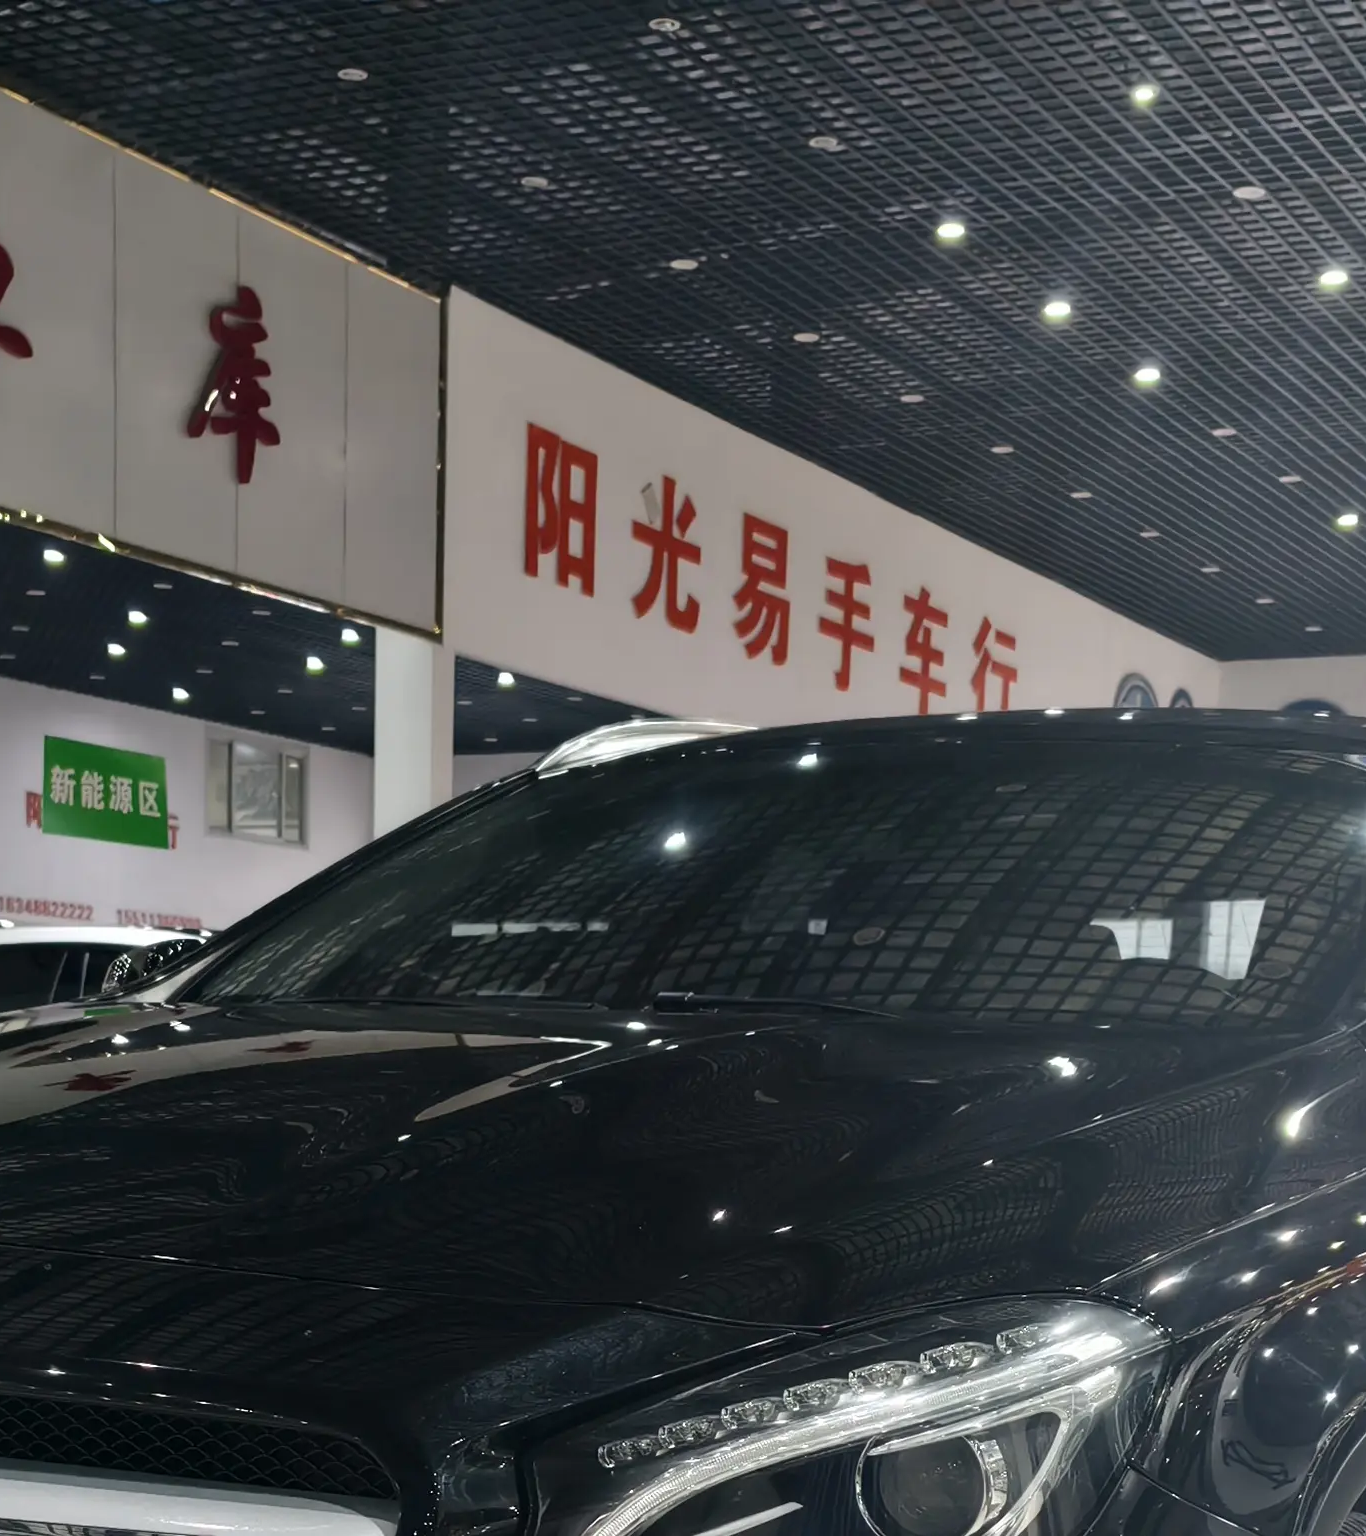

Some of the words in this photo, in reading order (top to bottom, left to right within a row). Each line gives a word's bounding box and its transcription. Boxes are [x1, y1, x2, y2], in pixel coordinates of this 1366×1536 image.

[524, 421, 1018, 716] 阳光易手车行
[50, 764, 161, 818] 新能源区
